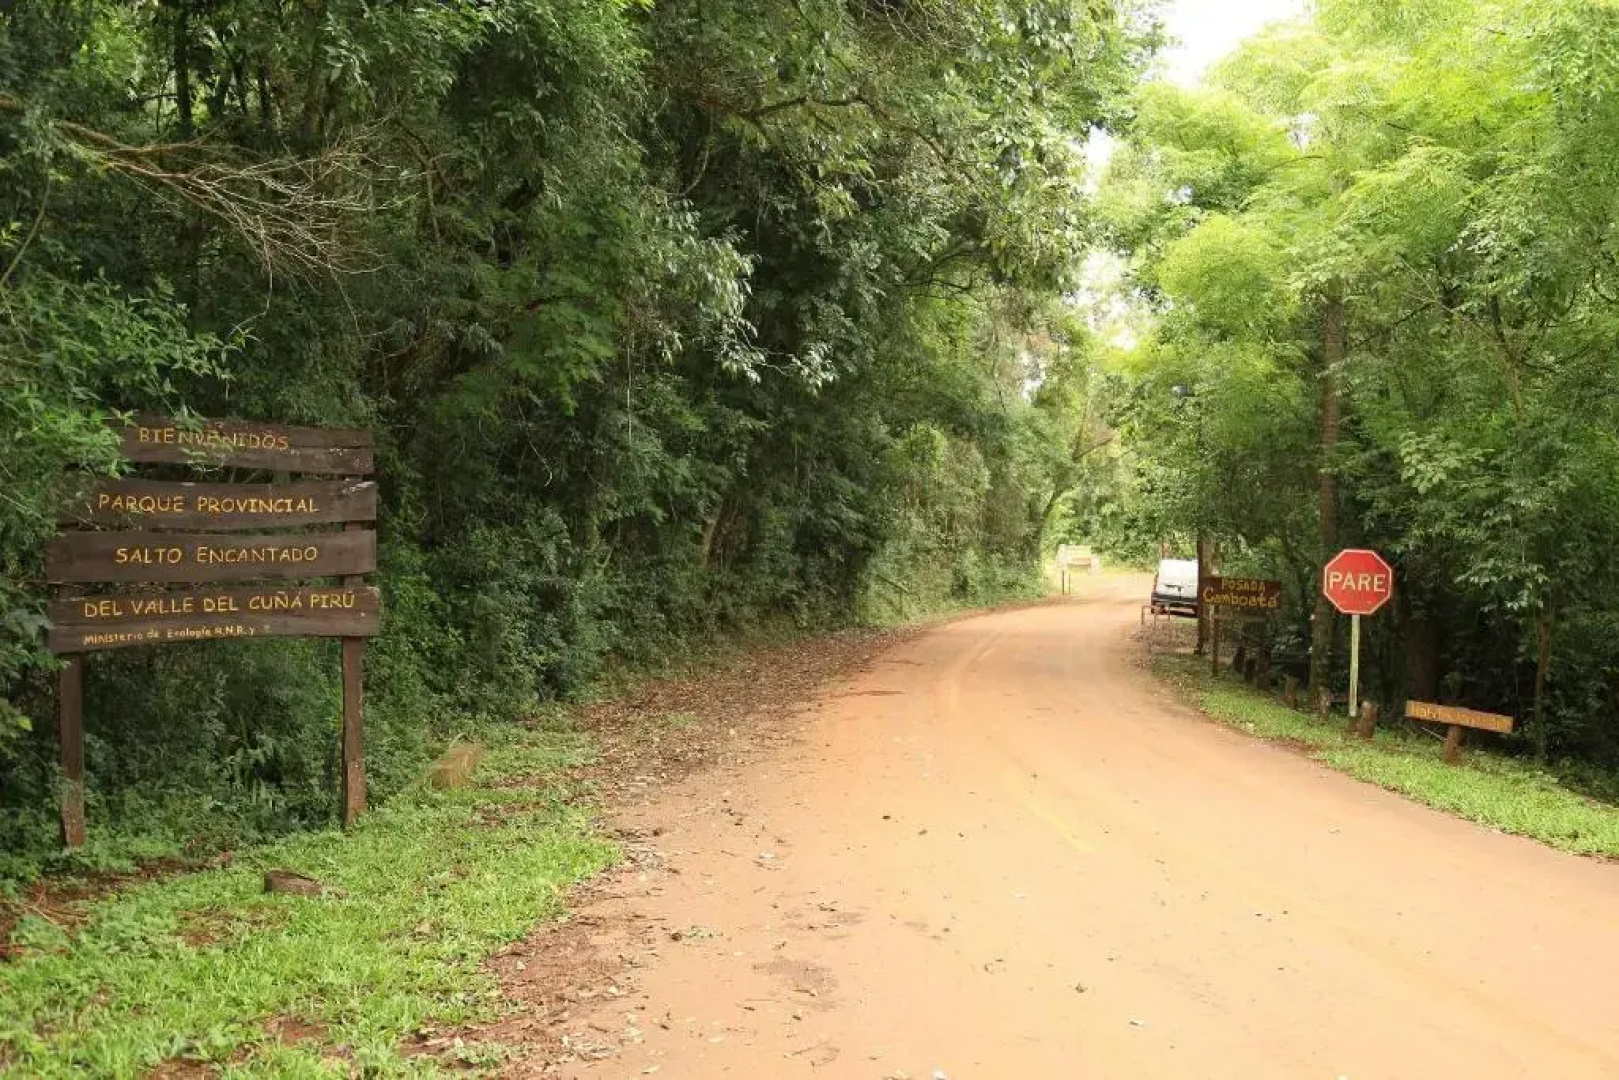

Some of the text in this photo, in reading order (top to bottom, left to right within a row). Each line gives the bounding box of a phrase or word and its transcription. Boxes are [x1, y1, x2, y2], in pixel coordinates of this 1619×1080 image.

[139, 427, 290, 450] BIENVENIDOS
[99, 494, 319, 513] PARQUE PROVINCIAL
[115, 547, 318, 564] SALTO ENCANTADO
[1222, 579, 1266, 592] POSADA
[1329, 571, 1386, 593] PARE
[84, 601, 122, 618] DEL
[131, 597, 193, 615] VALLE
[203, 595, 239, 613] DEL
[147, 627, 159, 638] de
